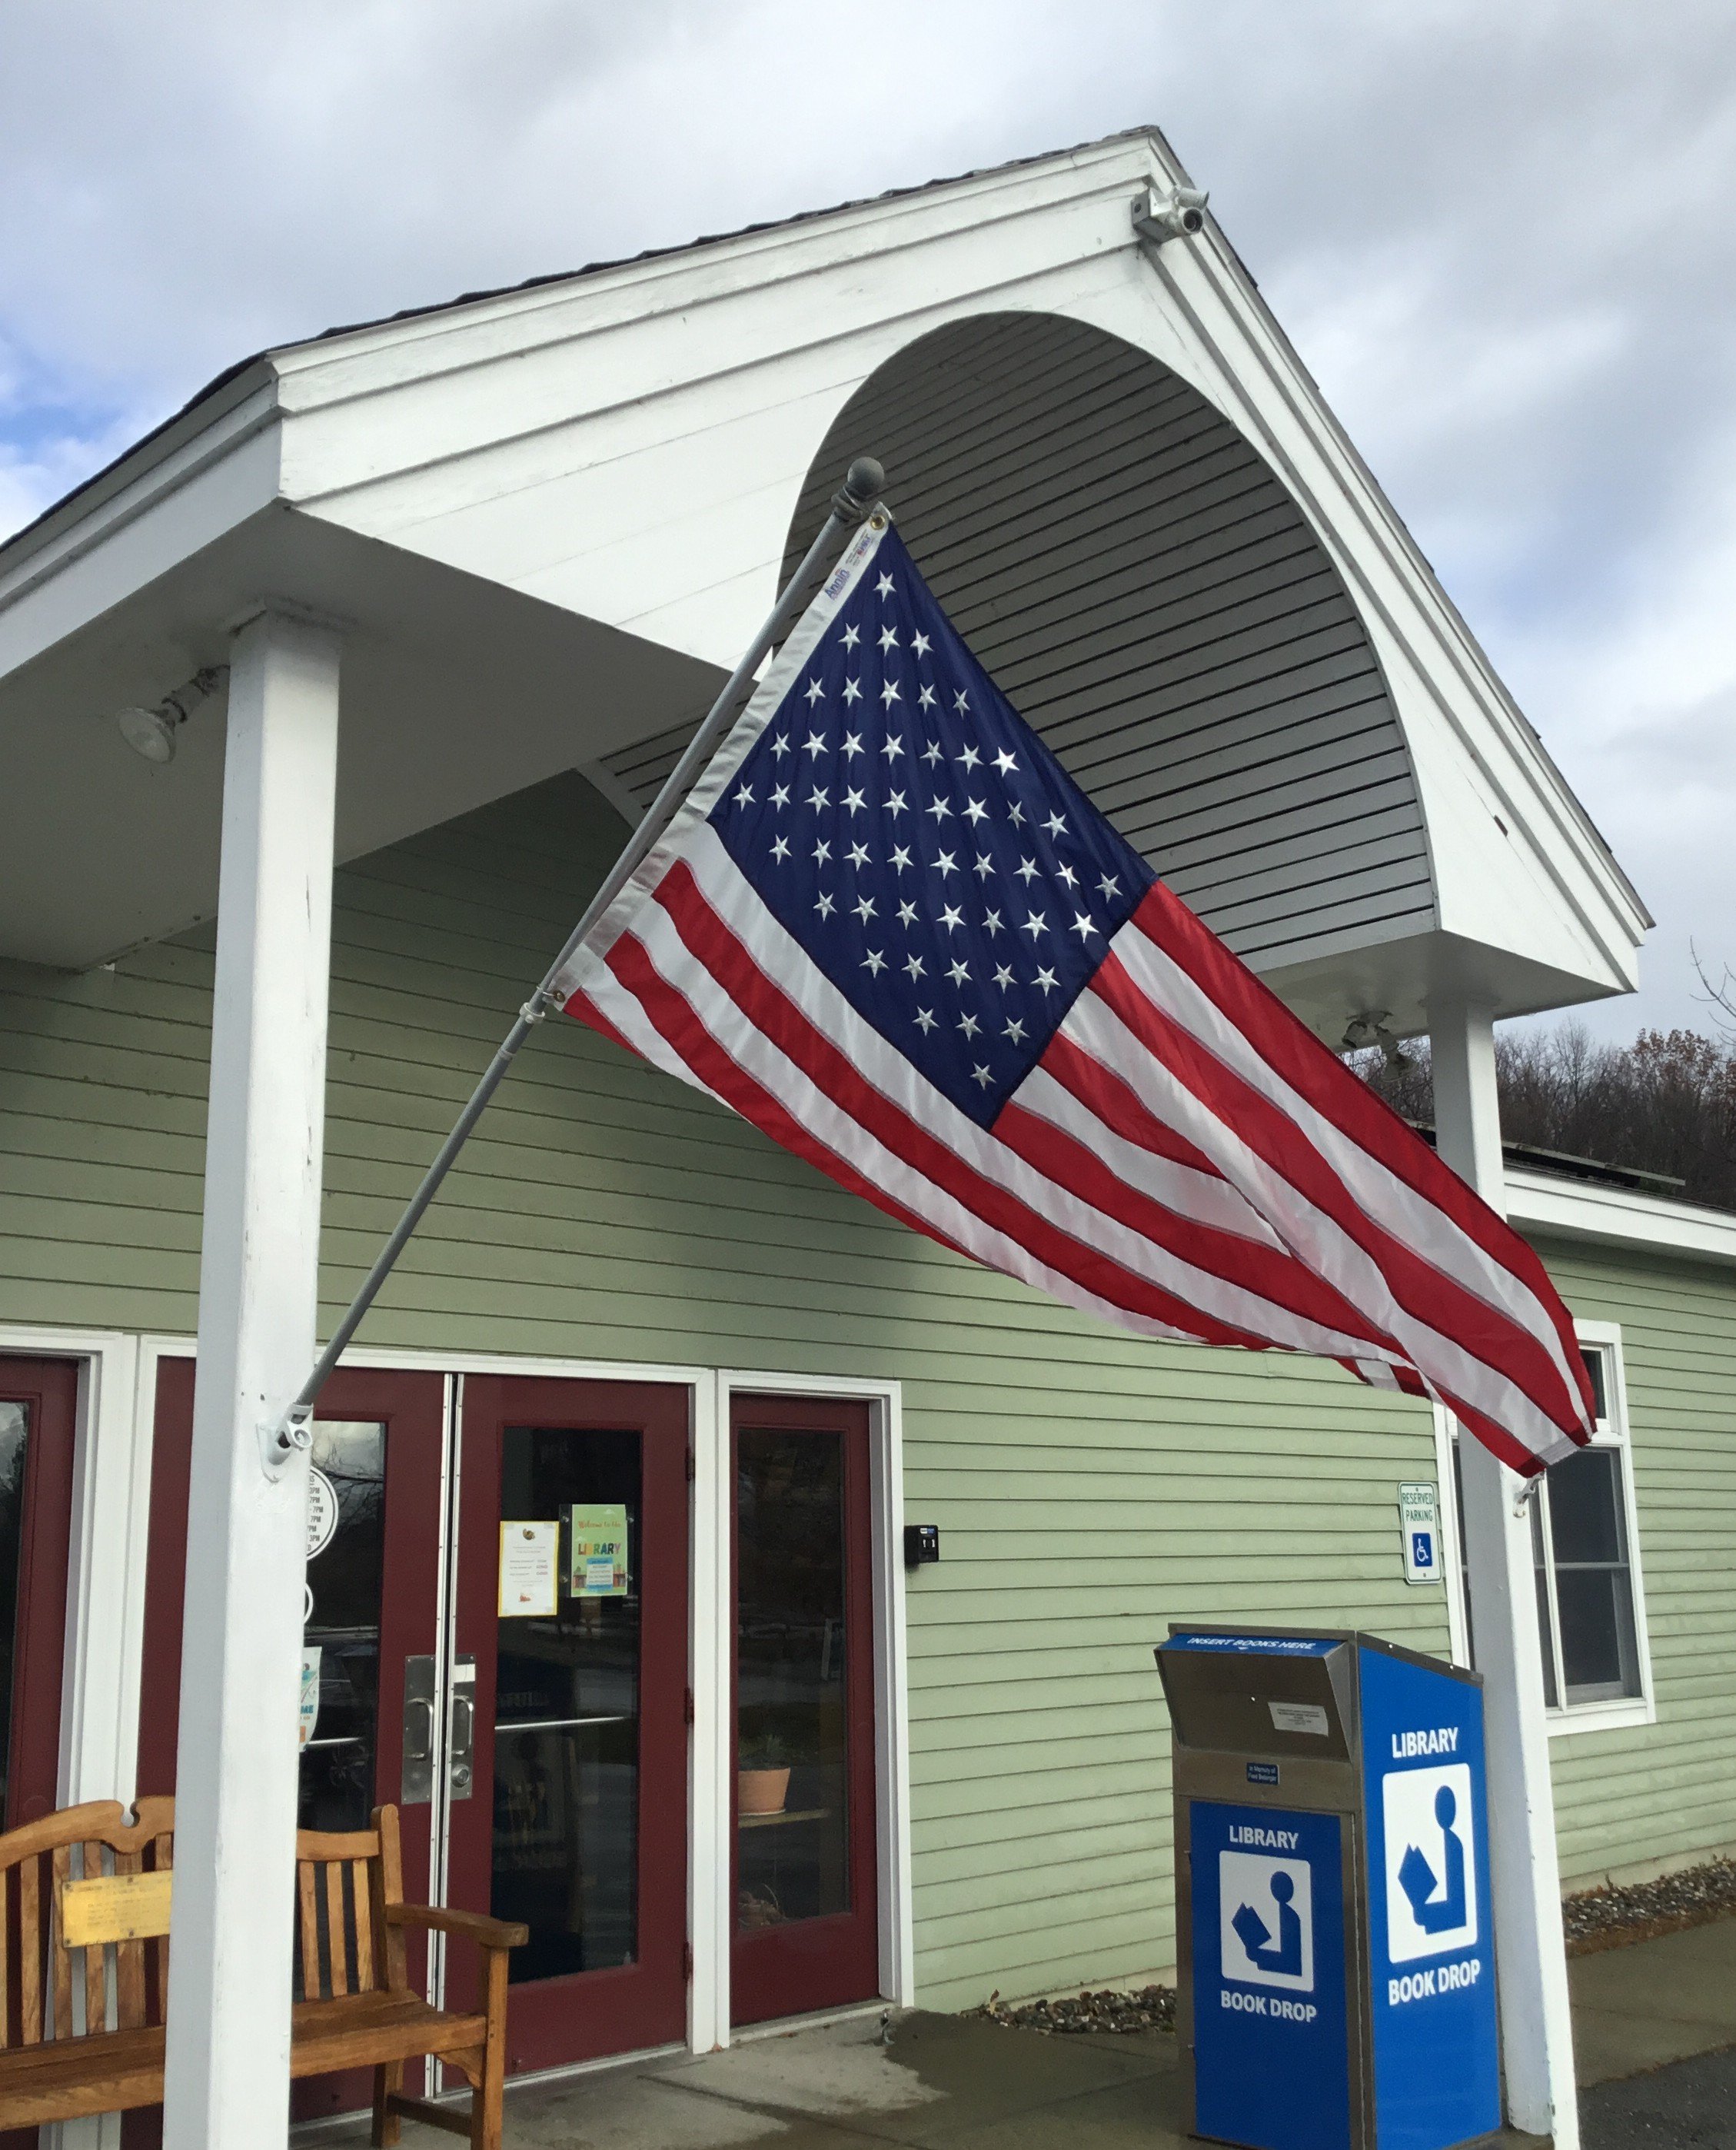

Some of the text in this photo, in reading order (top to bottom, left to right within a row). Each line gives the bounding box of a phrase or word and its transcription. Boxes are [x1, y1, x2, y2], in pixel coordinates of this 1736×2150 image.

[825, 568, 849, 597] Annin
[1402, 1493, 1434, 1505] RESERVED
[578, 1520, 602, 1529] Welcome
[1405, 1509, 1433, 1522] PARKING
[578, 1543, 621, 1556] LIBRARY
[1187, 1637, 1235, 1646] INSERT
[1278, 1641, 1316, 1649] HERE
[1392, 1727, 1458, 1759] LIBRARY
[1229, 1825, 1299, 1850] LIBRARY
[1388, 1959, 1481, 2006] BOOK DROP
[1221, 1990, 1317, 2022] BOOK DROP
